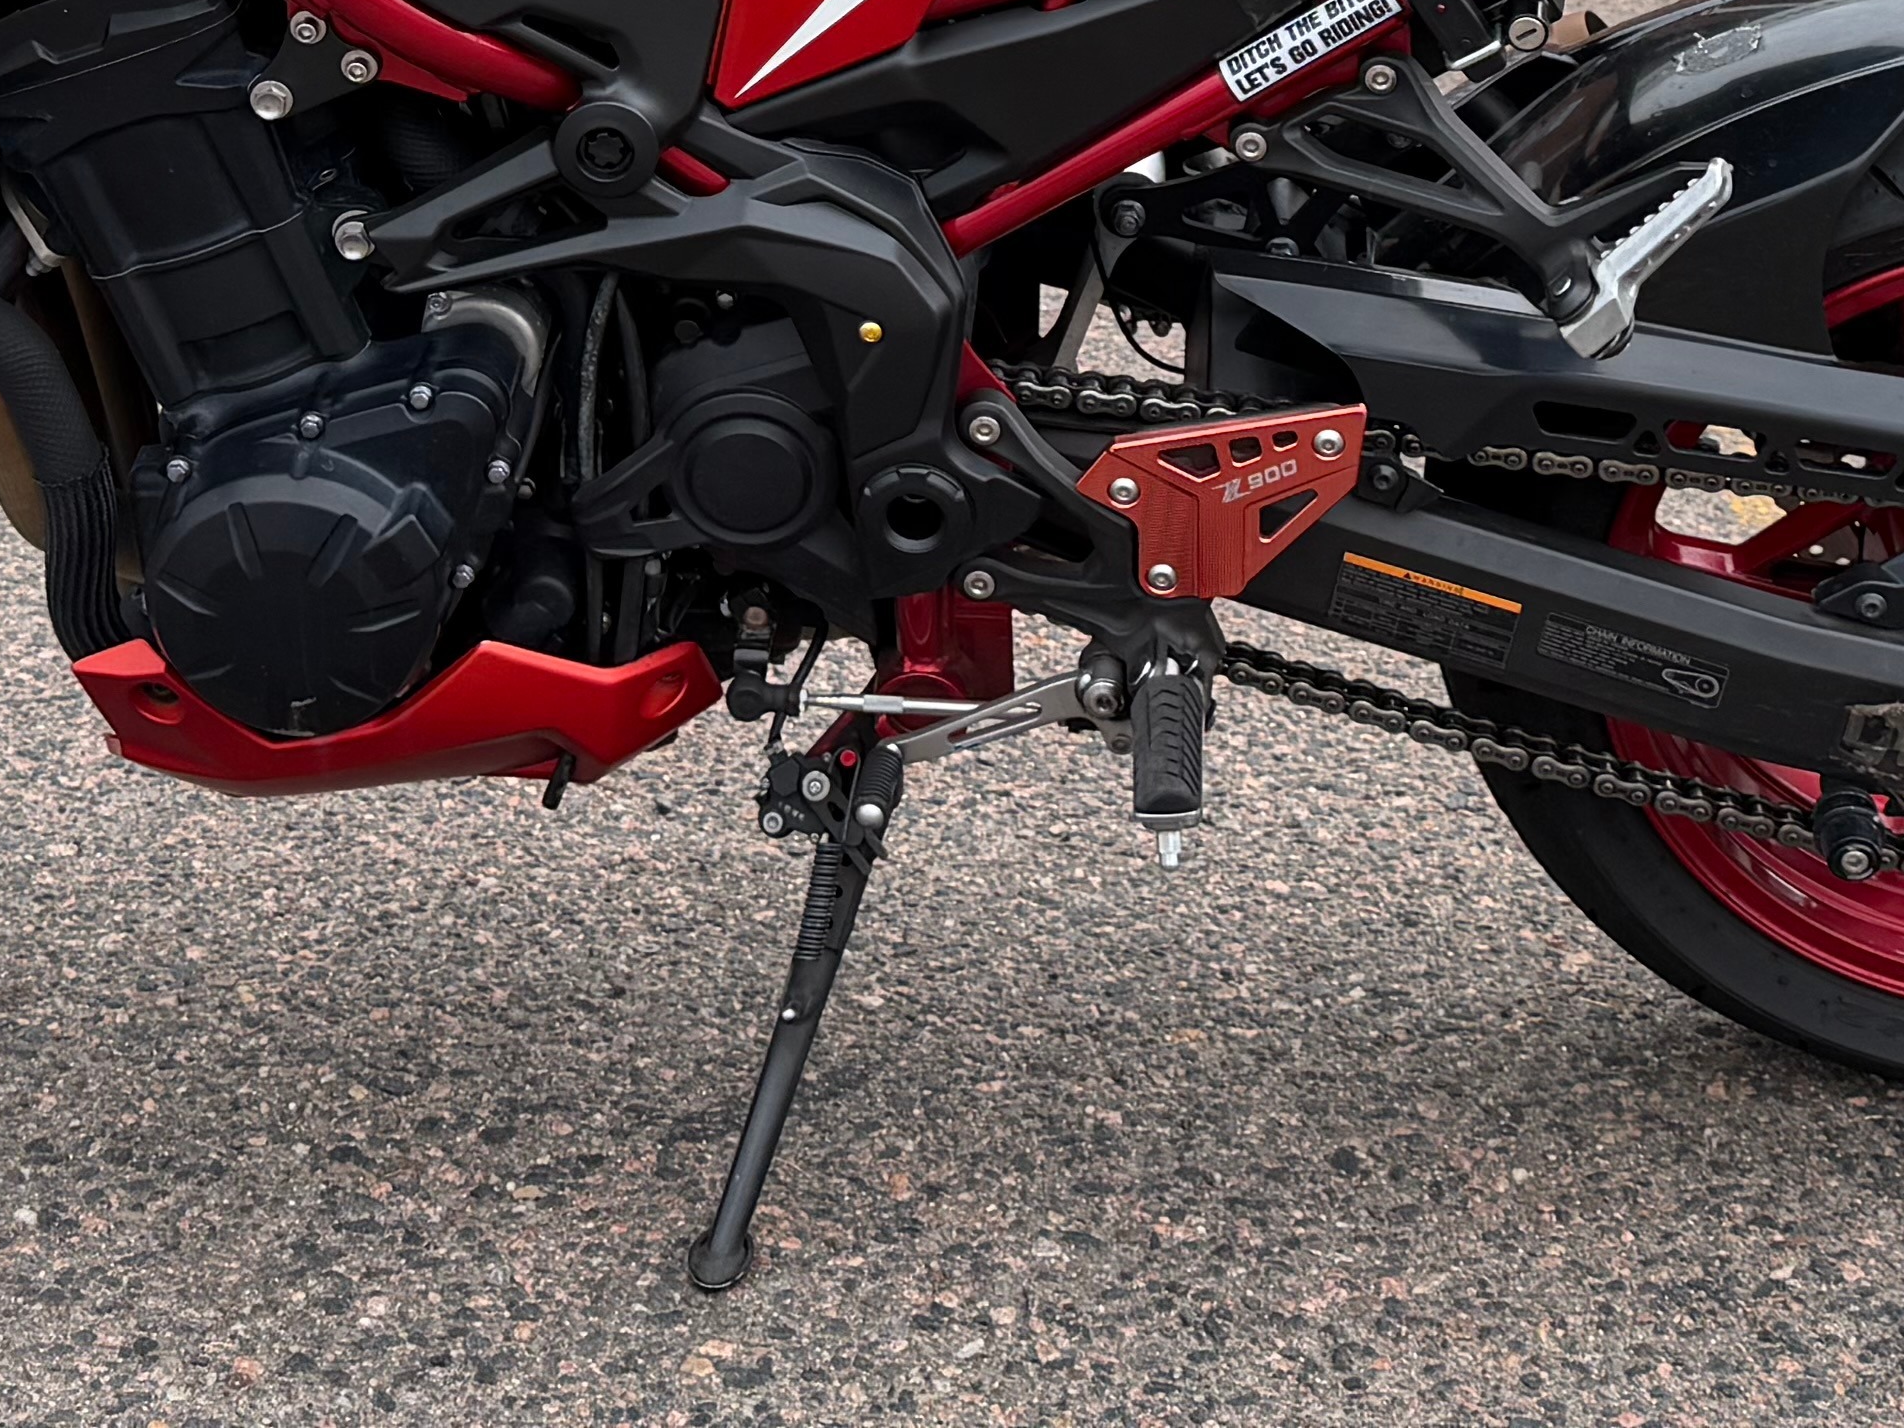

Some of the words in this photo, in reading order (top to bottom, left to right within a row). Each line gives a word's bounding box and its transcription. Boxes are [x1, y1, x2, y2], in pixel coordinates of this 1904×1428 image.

[1226, 33, 1284, 76] DITCH
[1284, 10, 1322, 42] THE
[1235, 56, 1288, 95] LET'S
[1288, 38, 1319, 66] GO
[1621, 637, 1691, 666] INFORMATION
